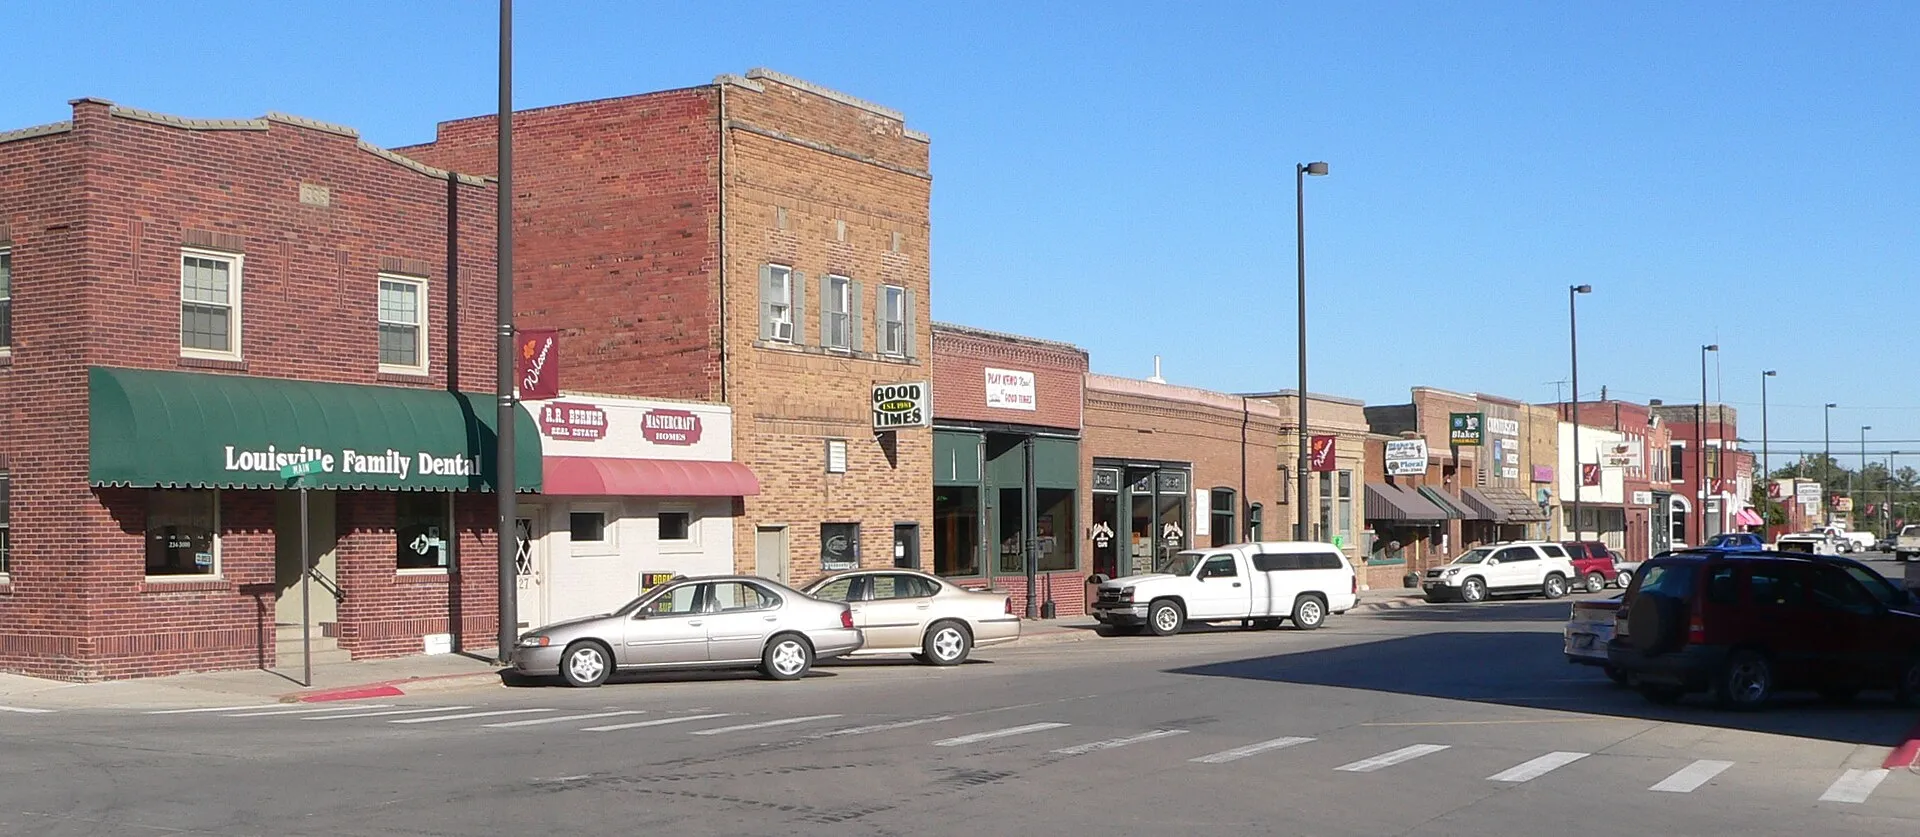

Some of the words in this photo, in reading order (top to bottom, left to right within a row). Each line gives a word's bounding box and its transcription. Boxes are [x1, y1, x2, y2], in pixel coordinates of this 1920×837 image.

[524, 336, 553, 391] Welcome
[873, 385, 921, 403] GOOD
[546, 408, 566, 423] R.R.
[646, 414, 696, 431] MASTERCRAFT
[873, 408, 922, 426] TIMES
[572, 428, 599, 437] ESTATE
[656, 432, 687, 441] HOMES
[1452, 430, 1480, 438] Blake's
[292, 462, 310, 475] MAIN
[342, 448, 411, 480] Family
[418, 451, 481, 476] Dental
